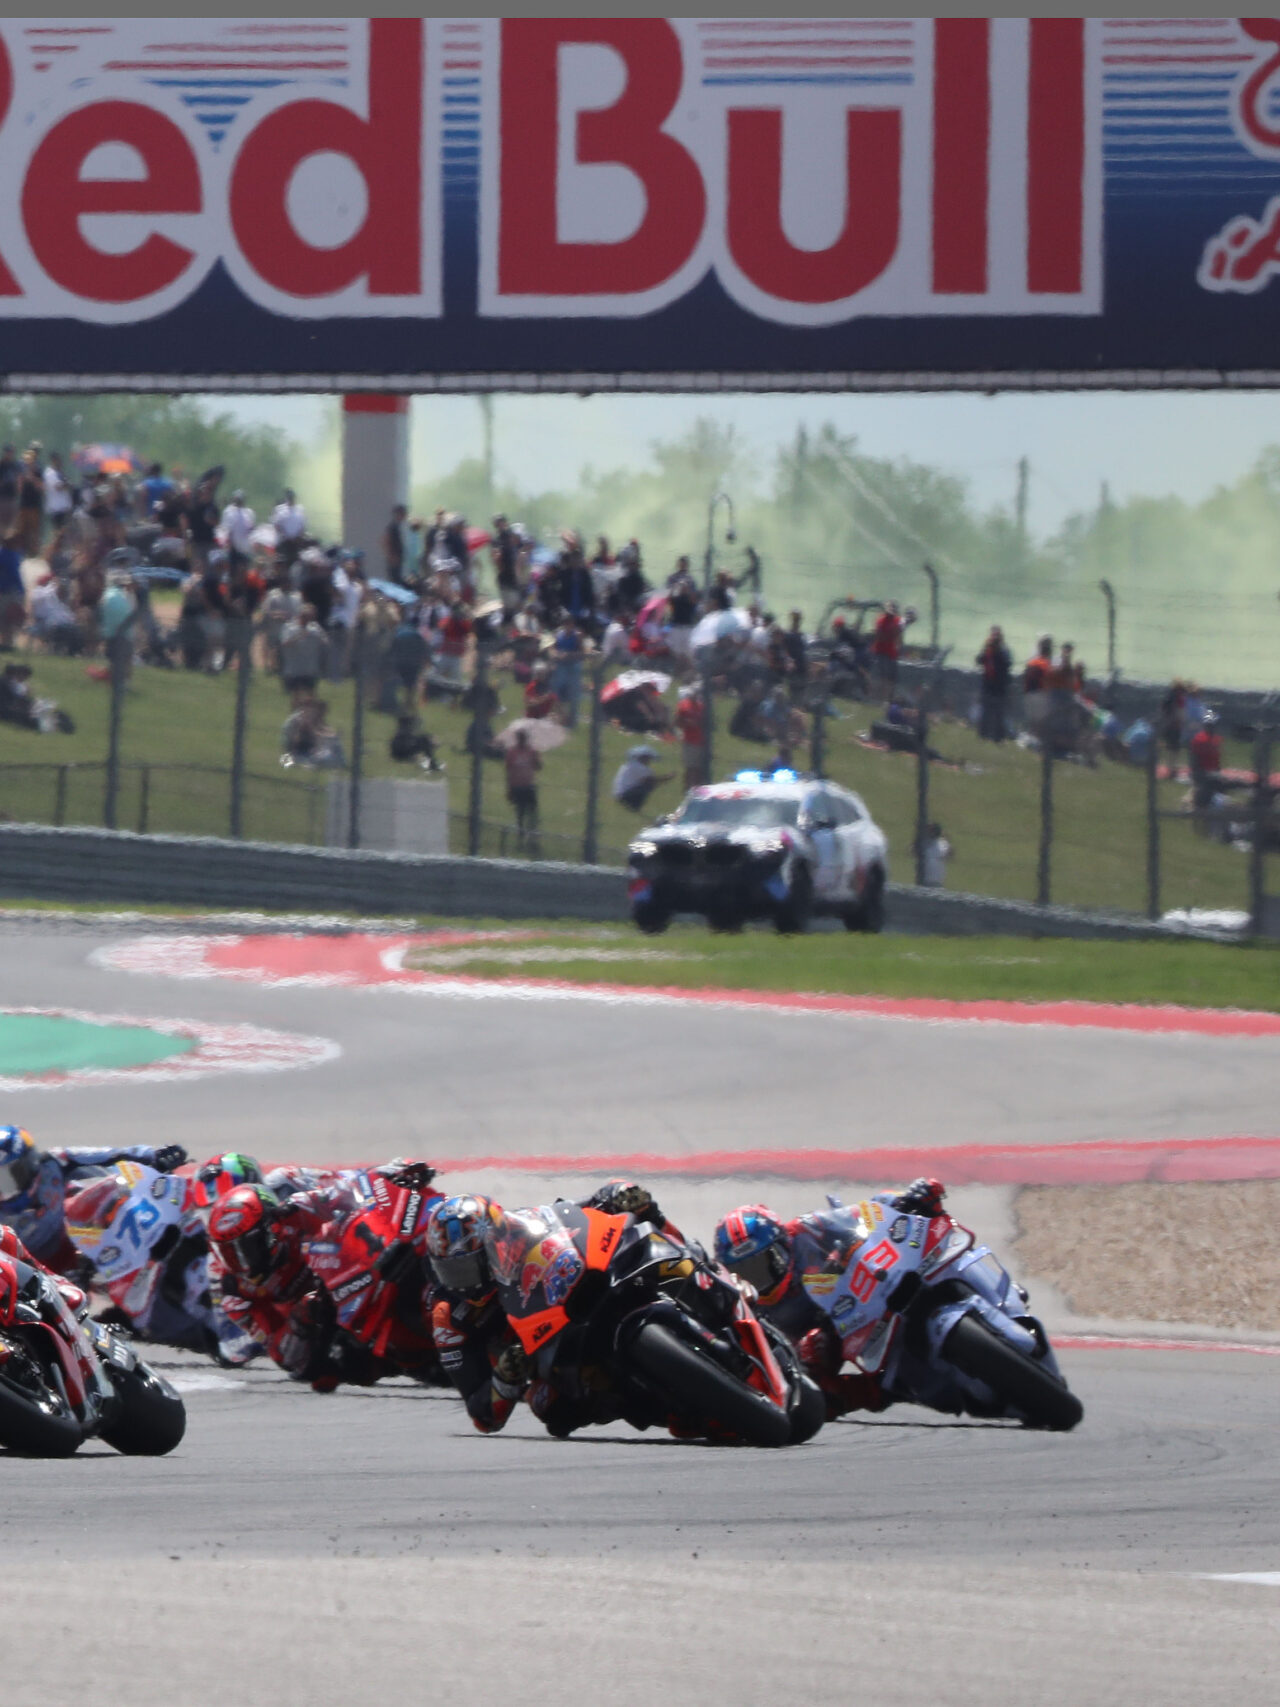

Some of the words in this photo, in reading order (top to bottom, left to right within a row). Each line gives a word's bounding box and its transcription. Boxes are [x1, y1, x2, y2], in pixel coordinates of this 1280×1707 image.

[497, 18, 1085, 304] Bull
[401, 1192, 421, 1235] Lenovo
[601, 1227, 616, 1253] KTM
[848, 1239, 901, 1304] 93
